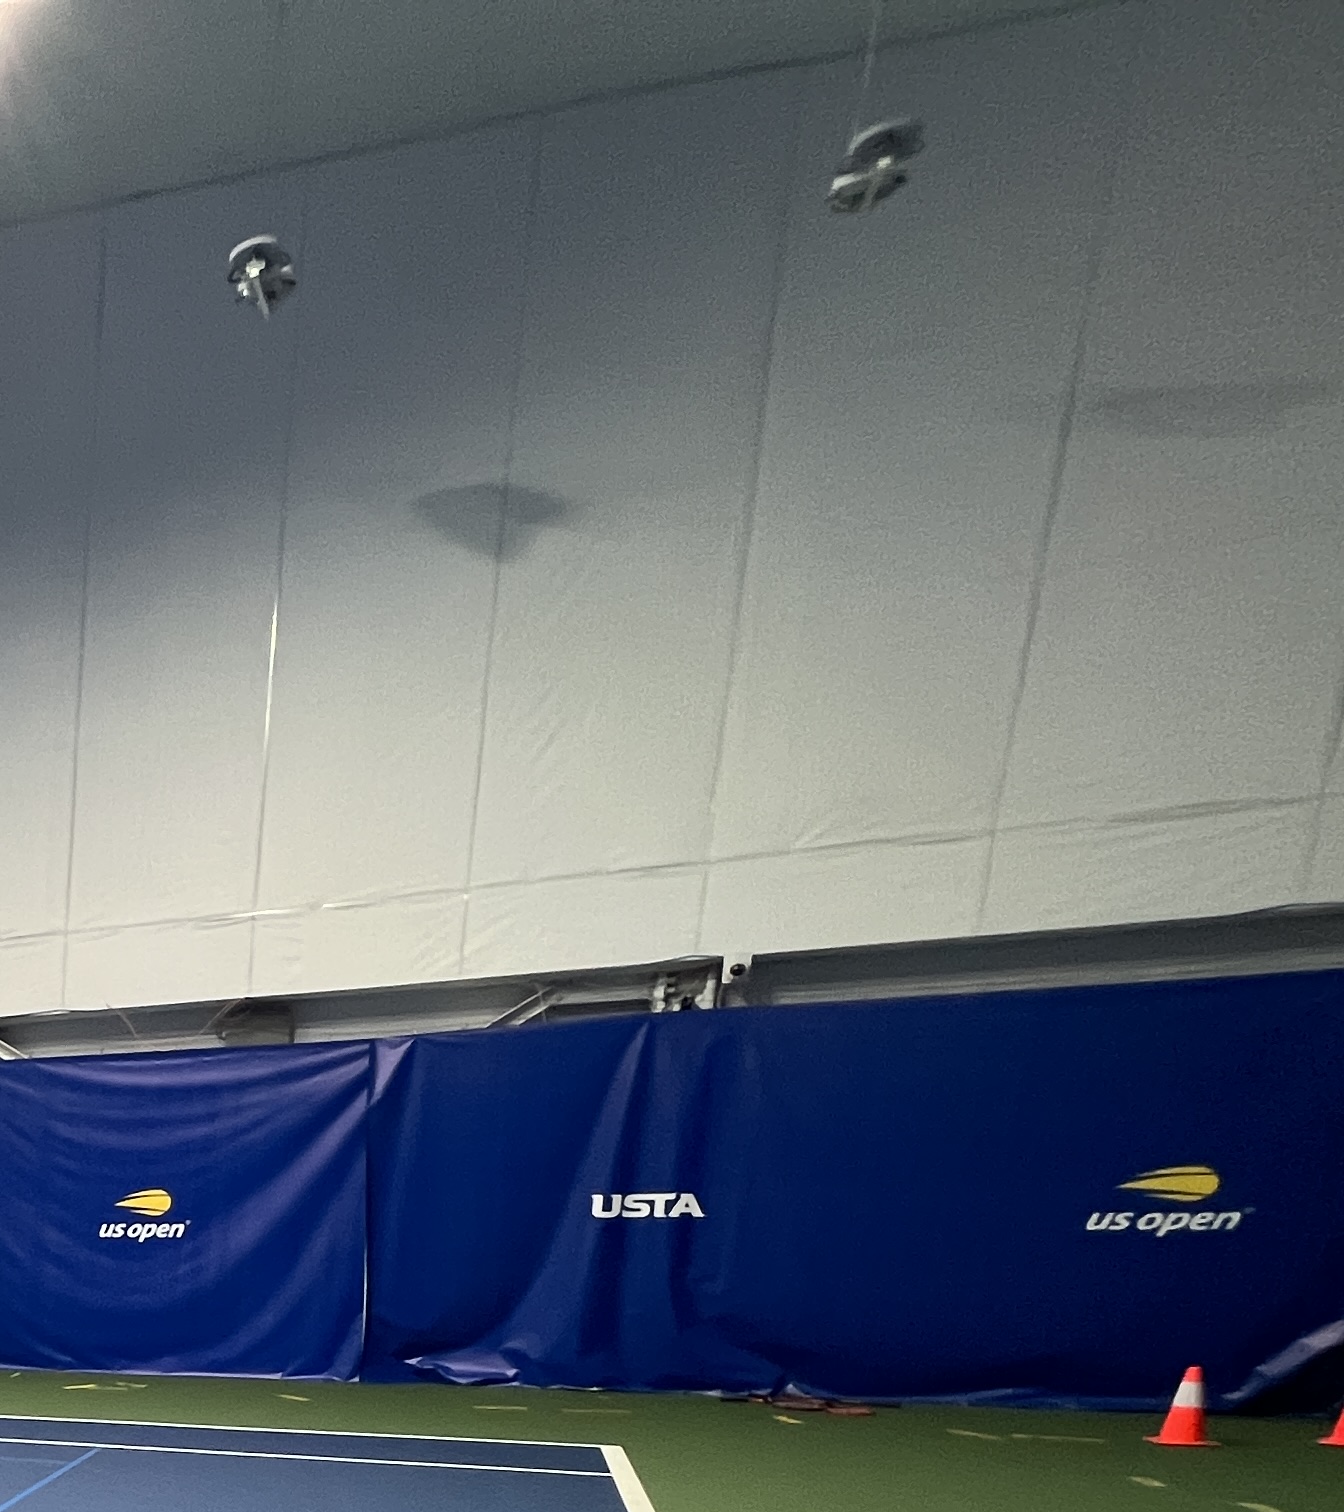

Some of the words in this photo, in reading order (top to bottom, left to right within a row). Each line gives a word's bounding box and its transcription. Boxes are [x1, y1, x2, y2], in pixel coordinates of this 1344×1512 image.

[591, 1192, 707, 1218] USTA
[99, 1223, 127, 1238] us
[126, 1223, 186, 1243] open
[1086, 1211, 1135, 1231] us
[1136, 1211, 1242, 1238] open
